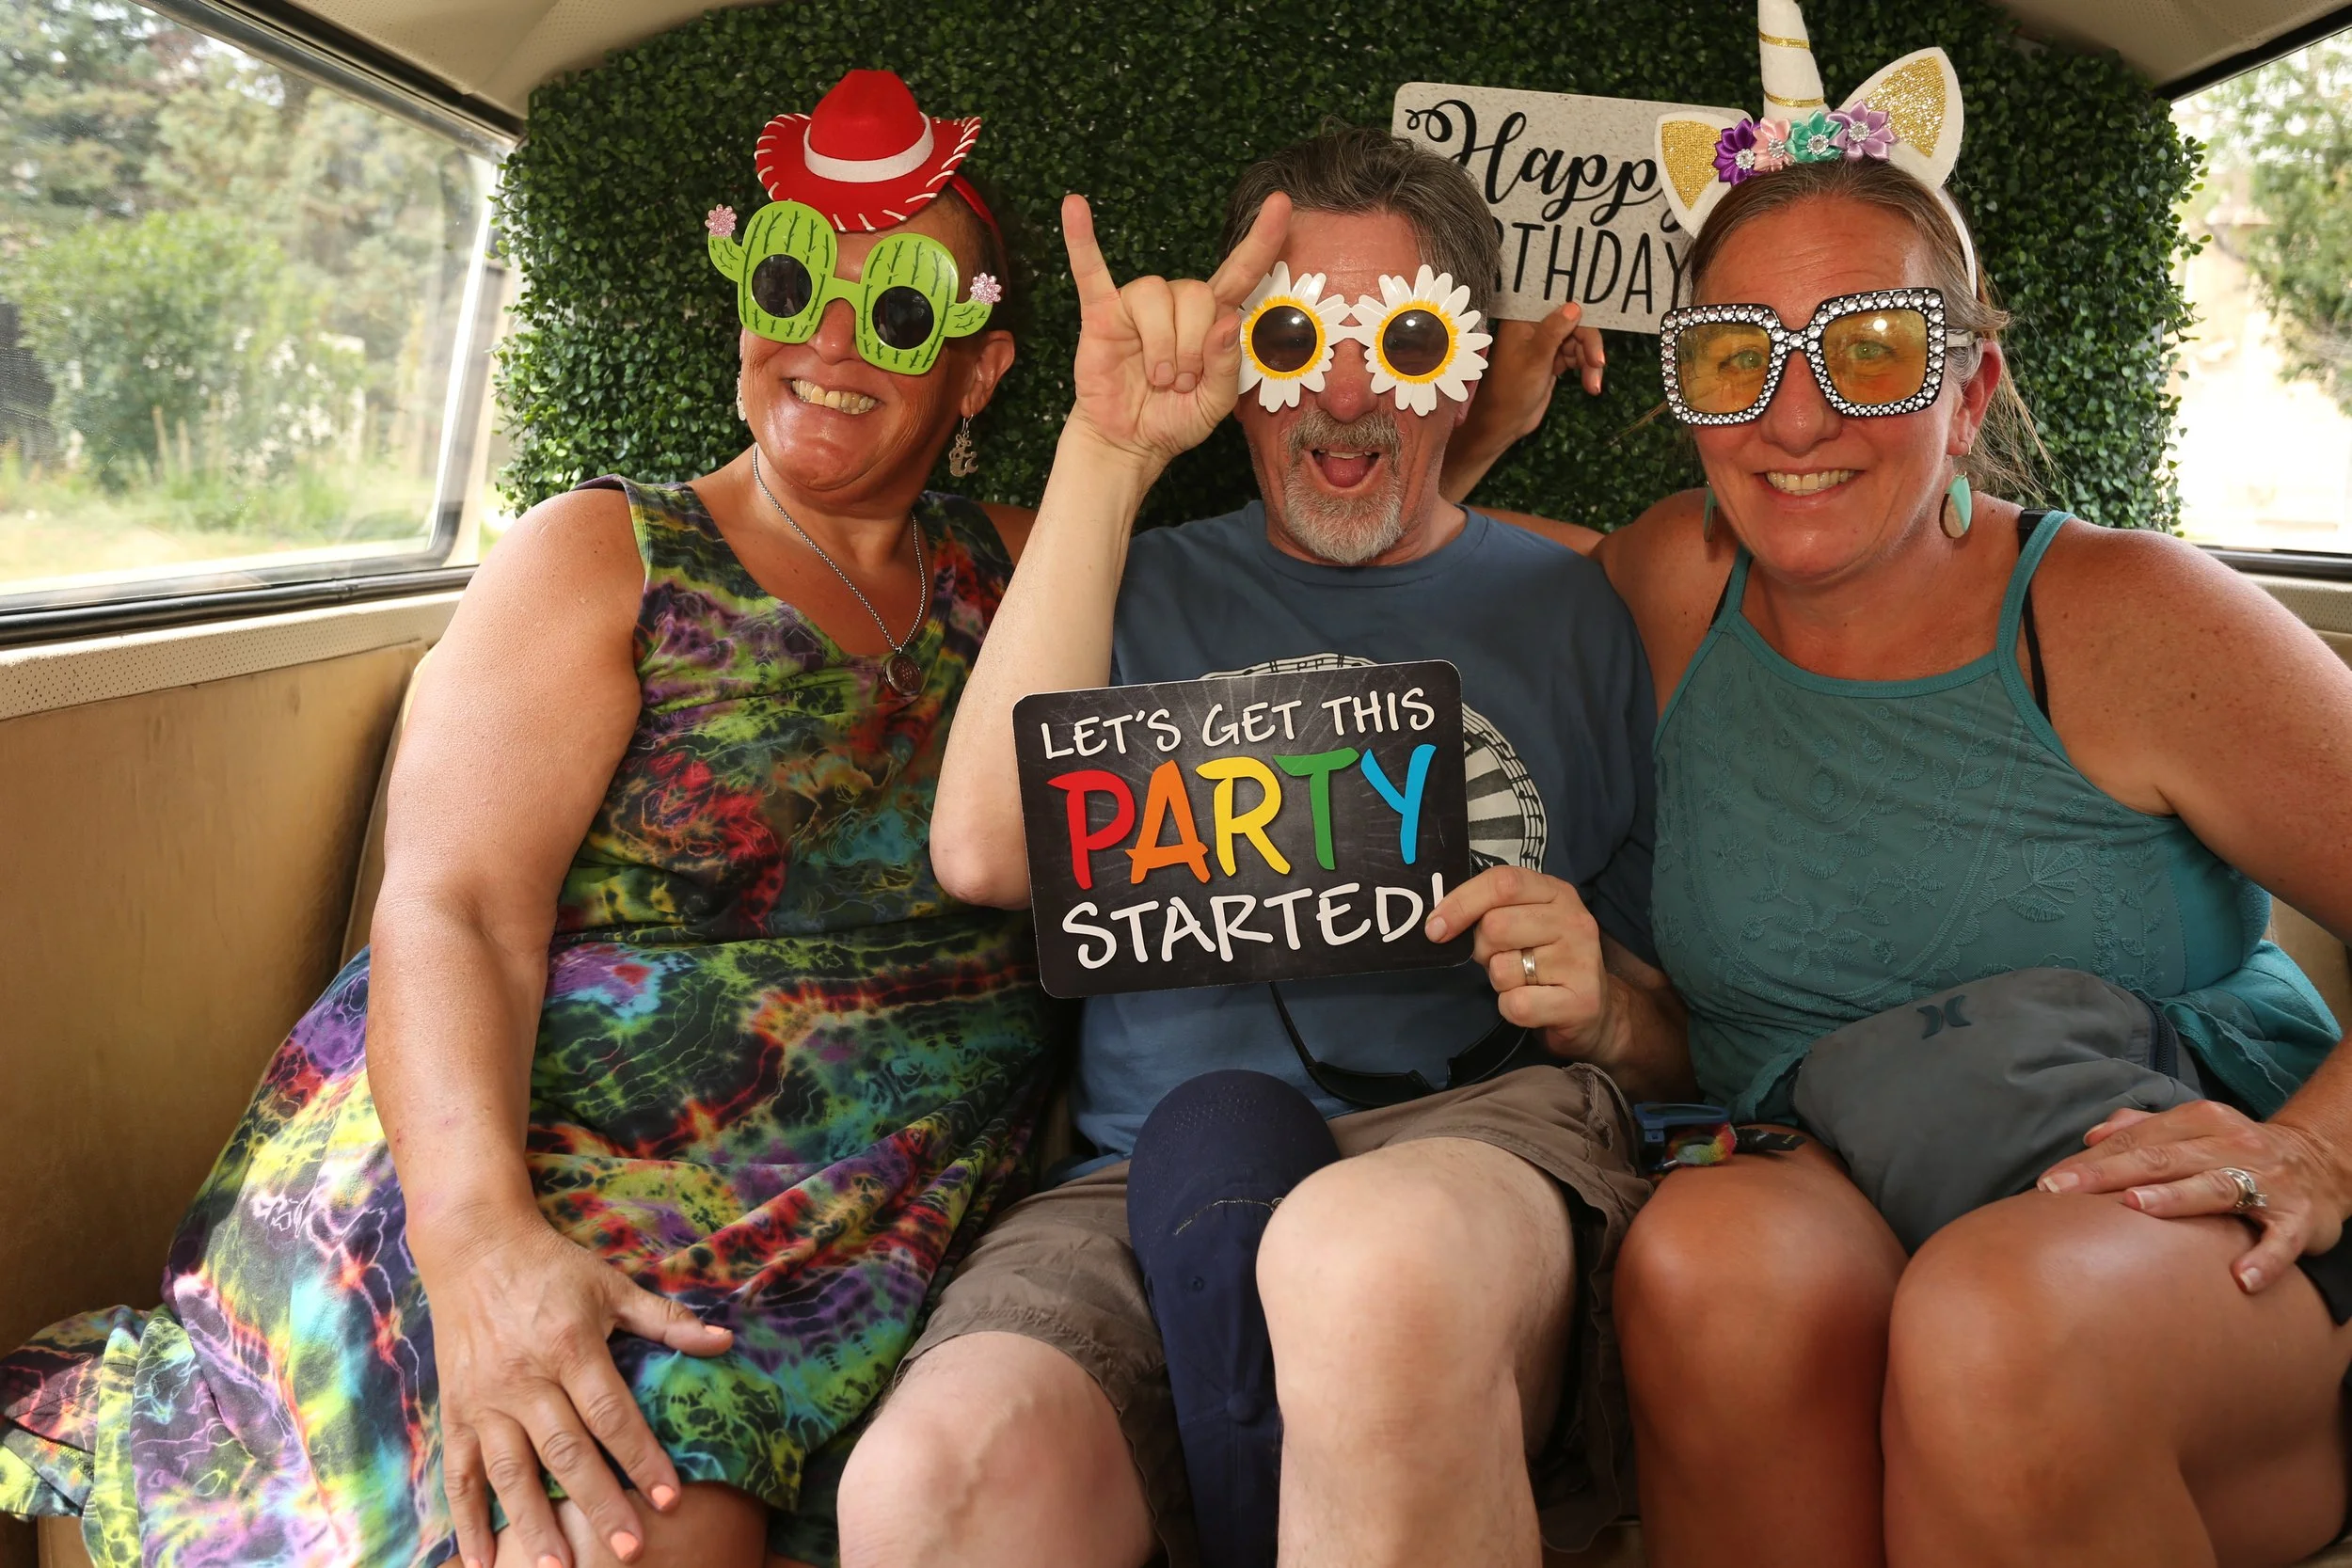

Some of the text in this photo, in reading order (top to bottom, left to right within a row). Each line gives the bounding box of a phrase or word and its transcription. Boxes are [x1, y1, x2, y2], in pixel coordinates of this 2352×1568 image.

[1040, 687, 1436, 760] LET'S GET THIS
[1046, 743, 1438, 891] PARTY
